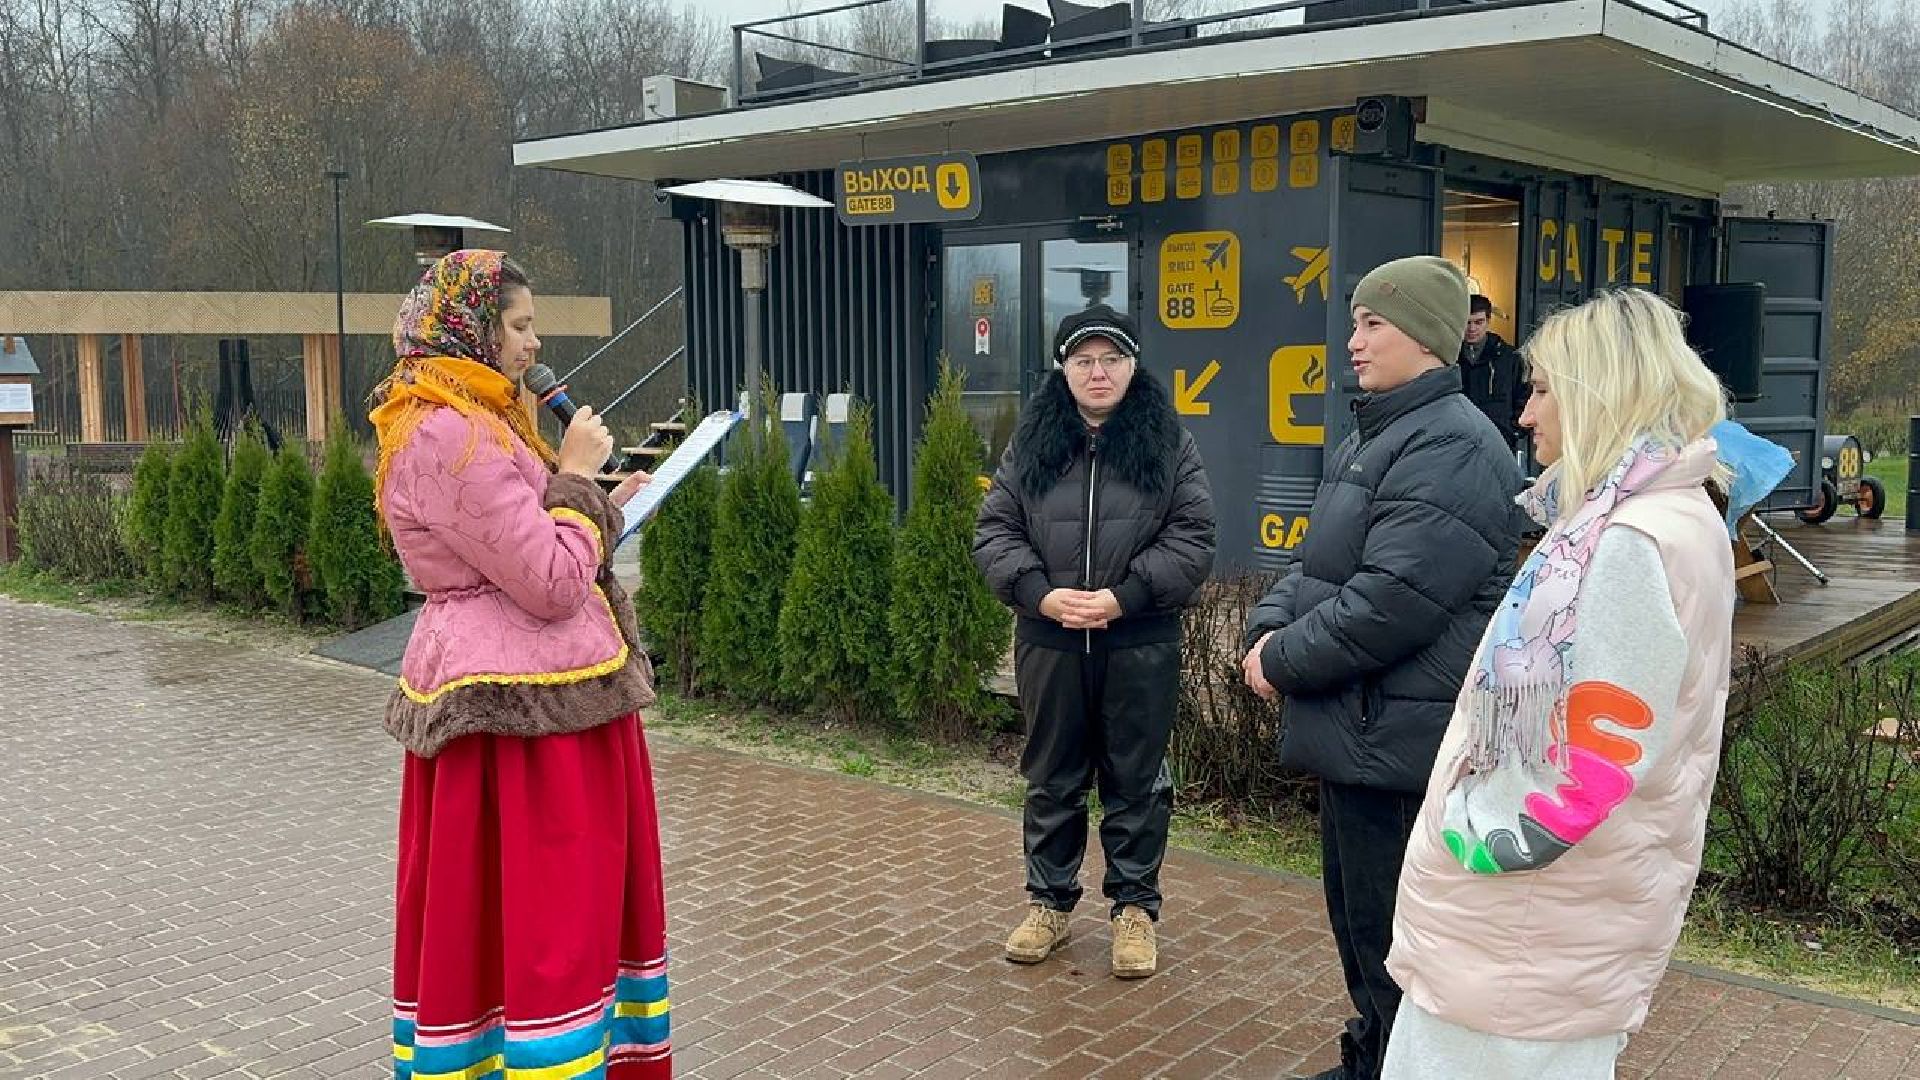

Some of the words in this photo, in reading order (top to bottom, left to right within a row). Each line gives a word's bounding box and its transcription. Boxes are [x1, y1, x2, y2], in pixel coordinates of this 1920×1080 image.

[843, 165, 930, 193] ВЫХОД
[848, 197, 892, 211] GATE88
[1540, 219, 1654, 284] GATE
[1167, 283, 1195, 293] GATE
[1167, 297, 1195, 318] 88
[1839, 447, 1858, 478] 88
